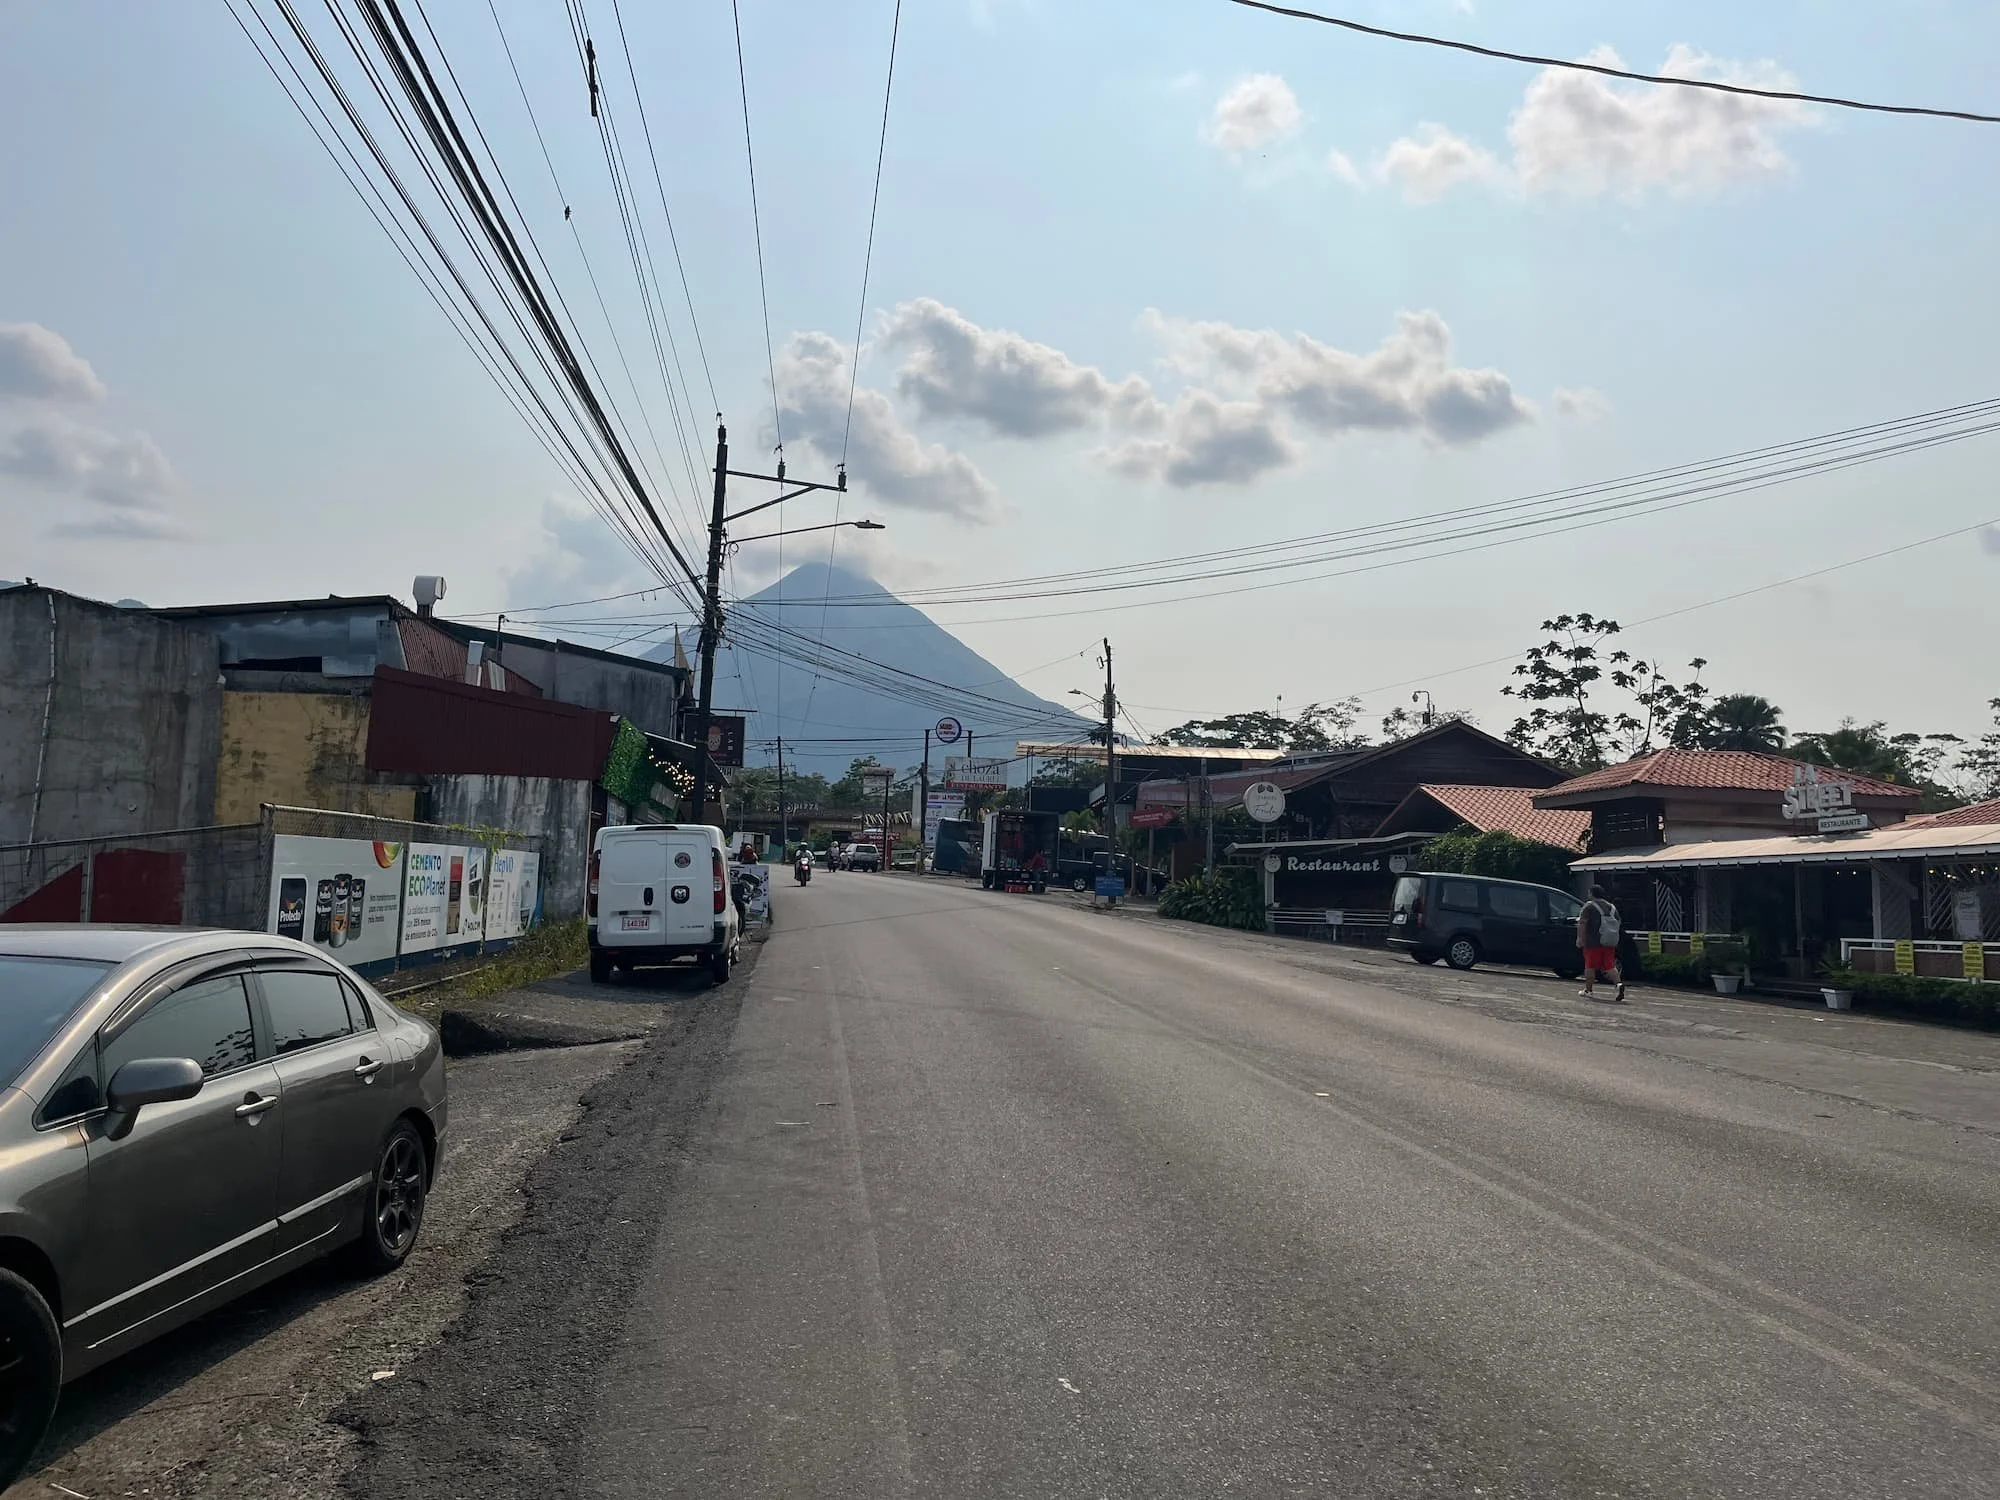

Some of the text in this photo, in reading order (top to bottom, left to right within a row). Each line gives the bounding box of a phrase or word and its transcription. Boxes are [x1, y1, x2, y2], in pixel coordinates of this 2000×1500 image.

[1820, 818, 1862, 829] RESTAURANTE
[410, 854, 442, 871] CEMENTO
[1286, 856, 1381, 872] Restaurant
